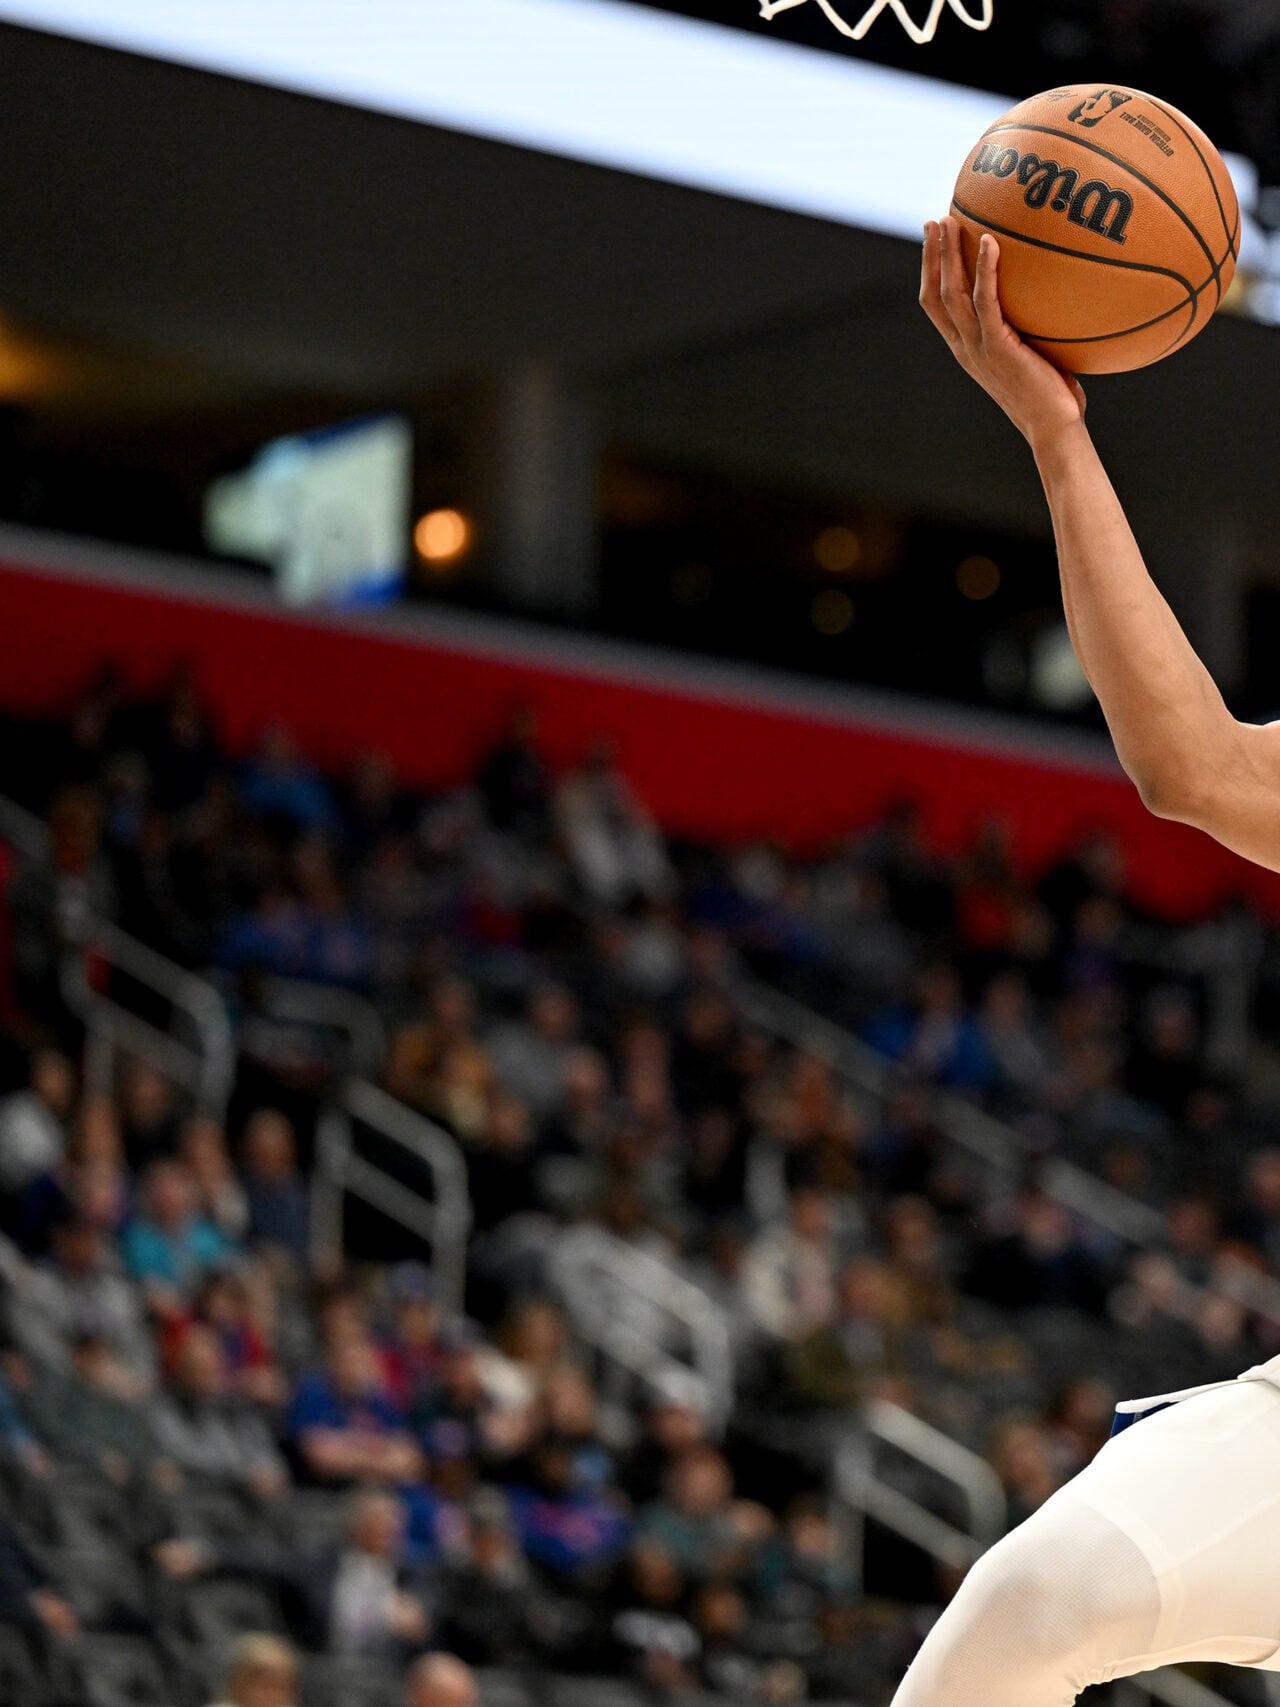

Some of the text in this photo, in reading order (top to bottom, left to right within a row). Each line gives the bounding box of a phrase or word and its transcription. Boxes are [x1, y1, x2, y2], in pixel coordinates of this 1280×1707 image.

[1119, 111, 1174, 157] OFFICIAL GAME BALL
[971, 143, 1134, 246] Wilson
